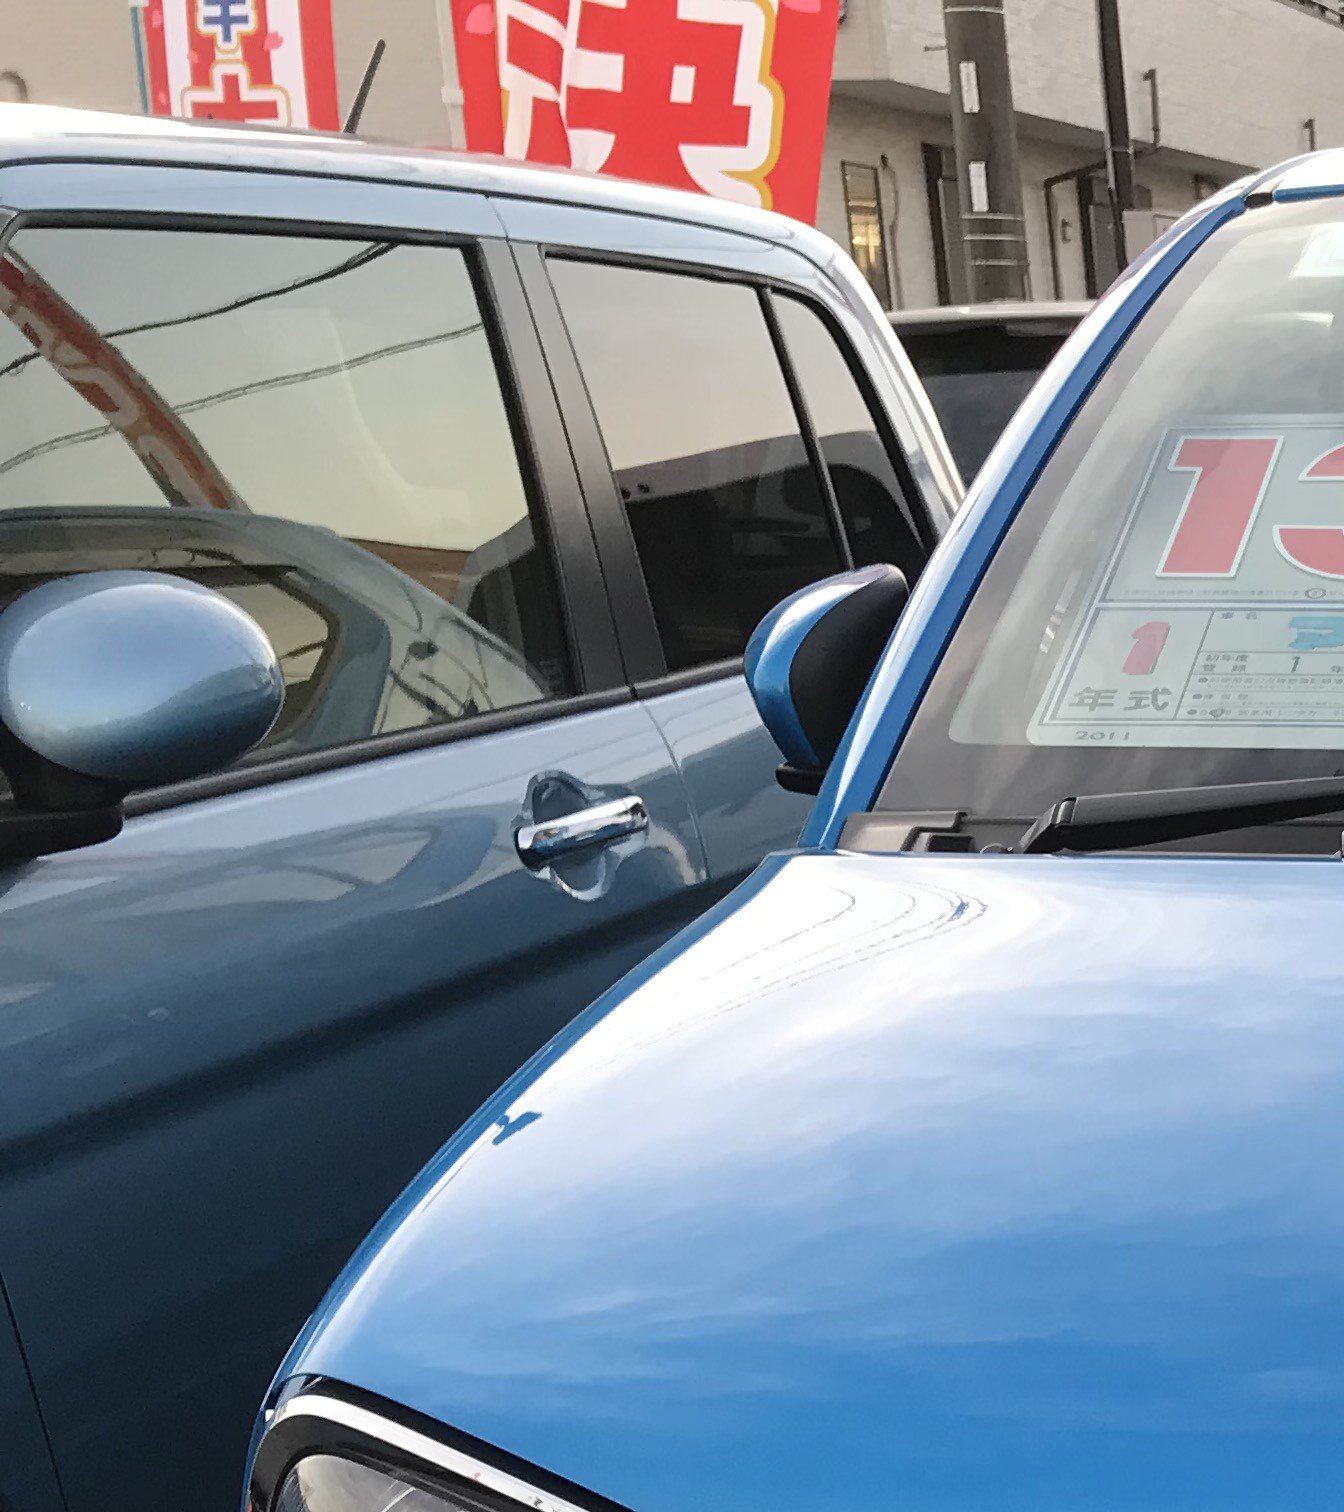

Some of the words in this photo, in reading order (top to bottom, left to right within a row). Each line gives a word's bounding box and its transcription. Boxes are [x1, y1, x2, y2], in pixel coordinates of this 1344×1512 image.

[1121, 620, 1171, 676] 1
[1290, 656, 1301, 674] 1
[1068, 686, 1173, 712] 年式
[1073, 730, 1131, 742] 2011
